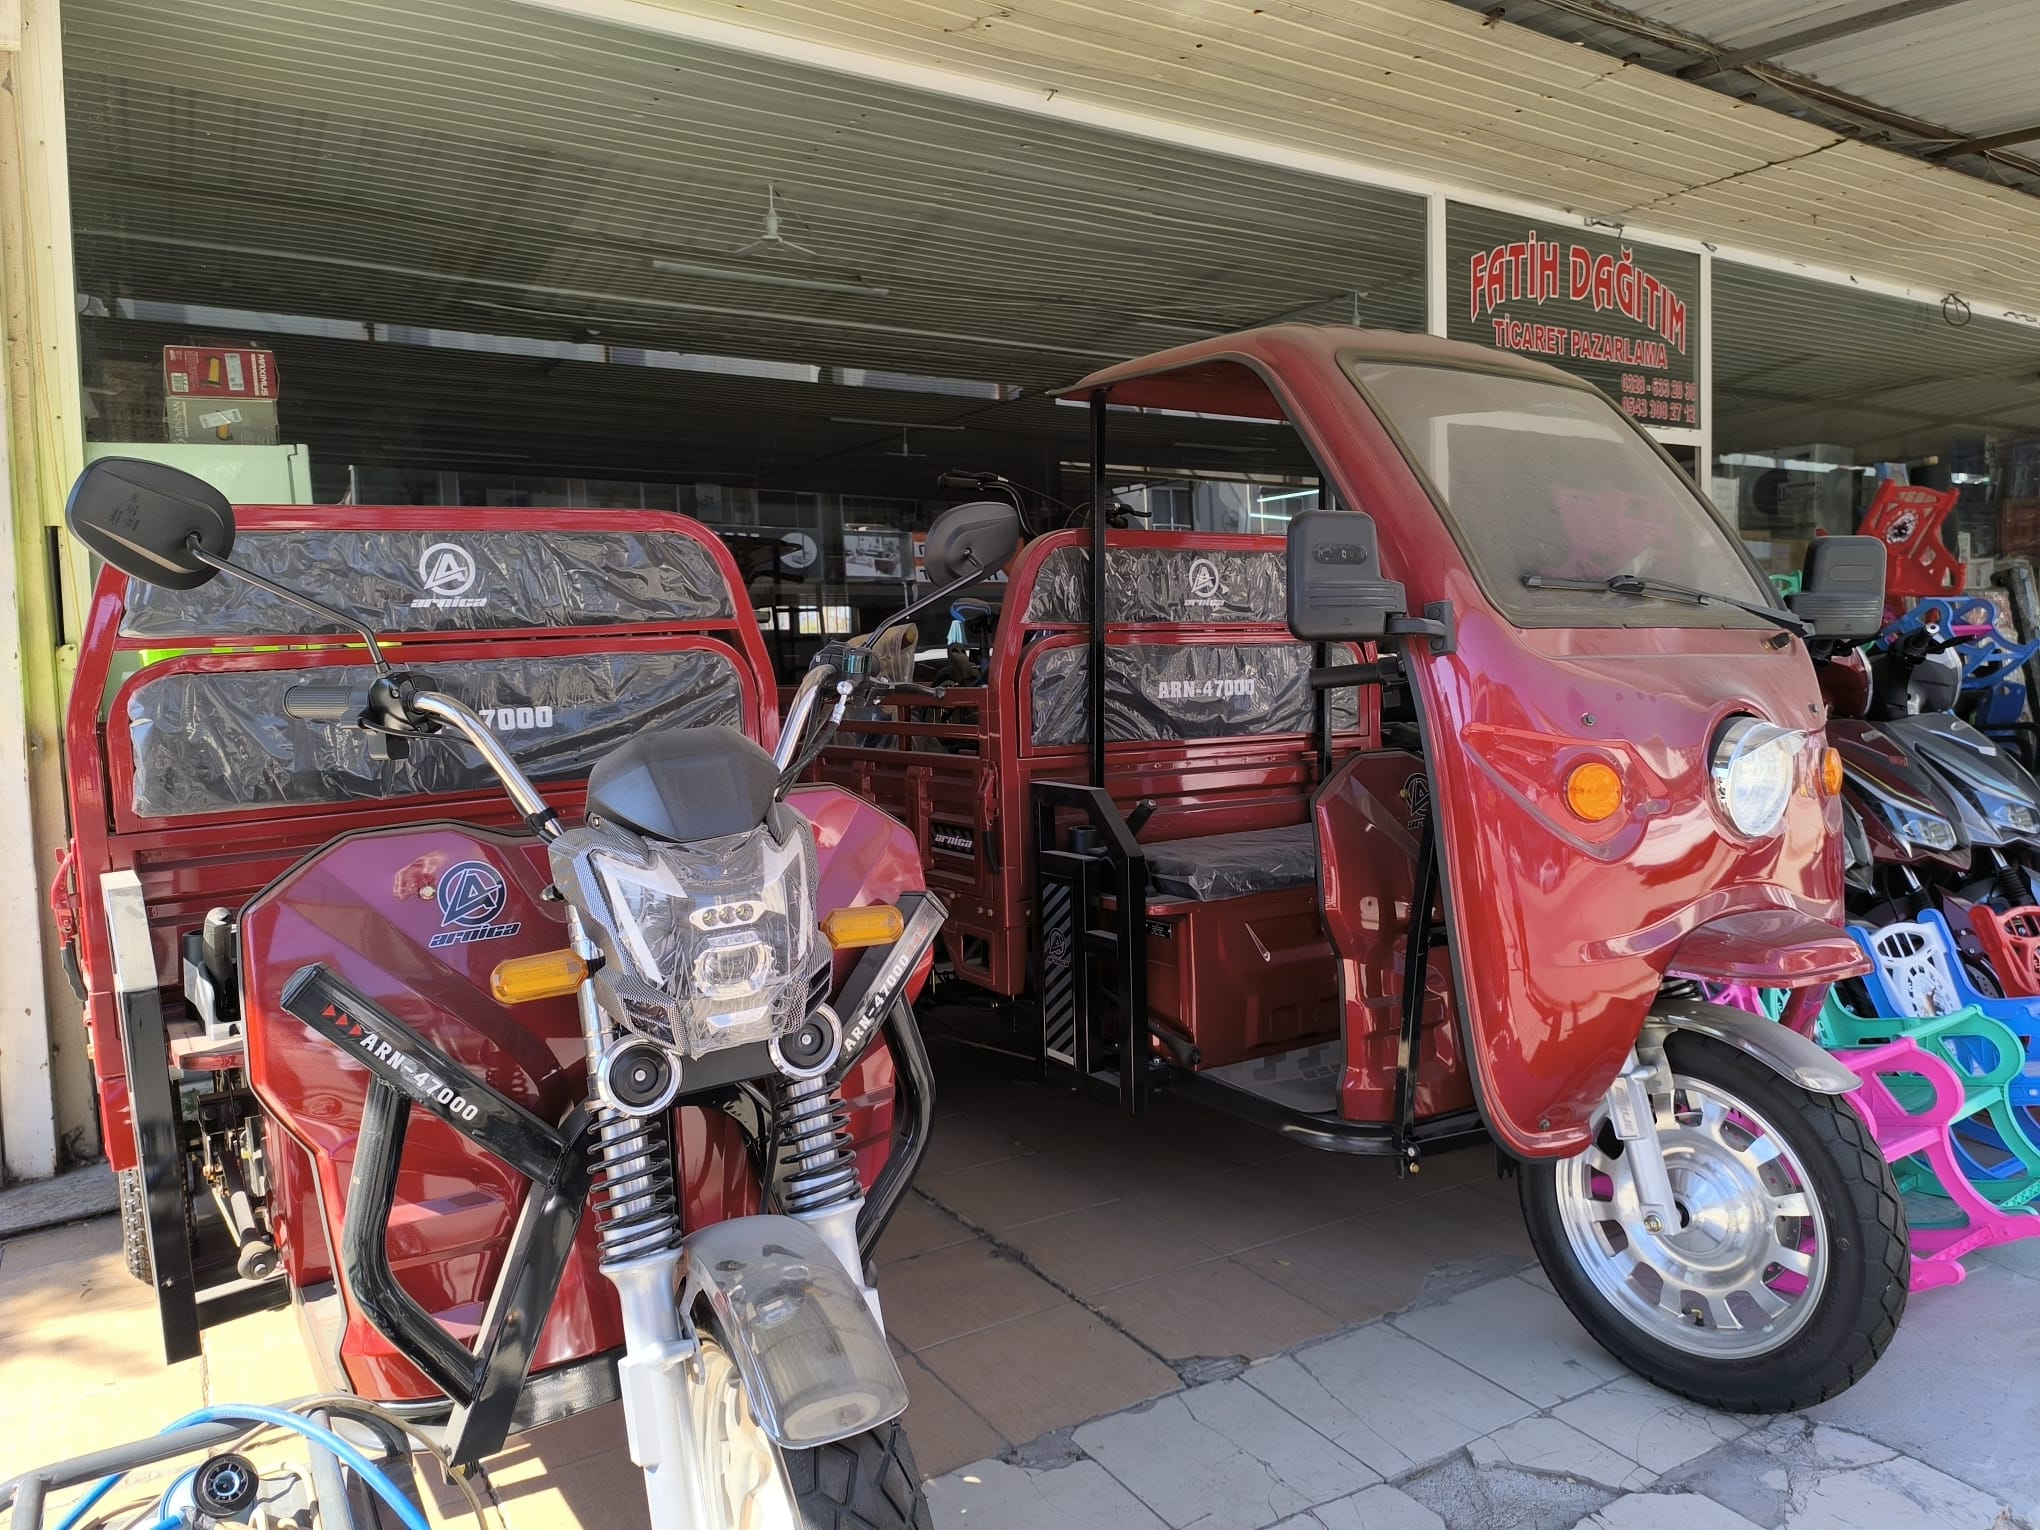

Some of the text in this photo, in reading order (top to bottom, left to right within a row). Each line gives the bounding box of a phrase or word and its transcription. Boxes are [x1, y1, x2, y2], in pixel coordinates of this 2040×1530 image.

[1470, 230, 1686, 356] FATİH DAĞITIM
[1492, 313, 1669, 370] TİCARET PAZARLAMA
[257, 354, 269, 397] MAXIMUS
[410, 595, 488, 609] arnica
[1158, 679, 1255, 699] ARN-47000
[935, 834, 973, 848] arnica
[428, 922, 522, 949] arnica
[844, 954, 910, 1052] ARN-47000
[360, 1032, 479, 1121] ARN-47000
